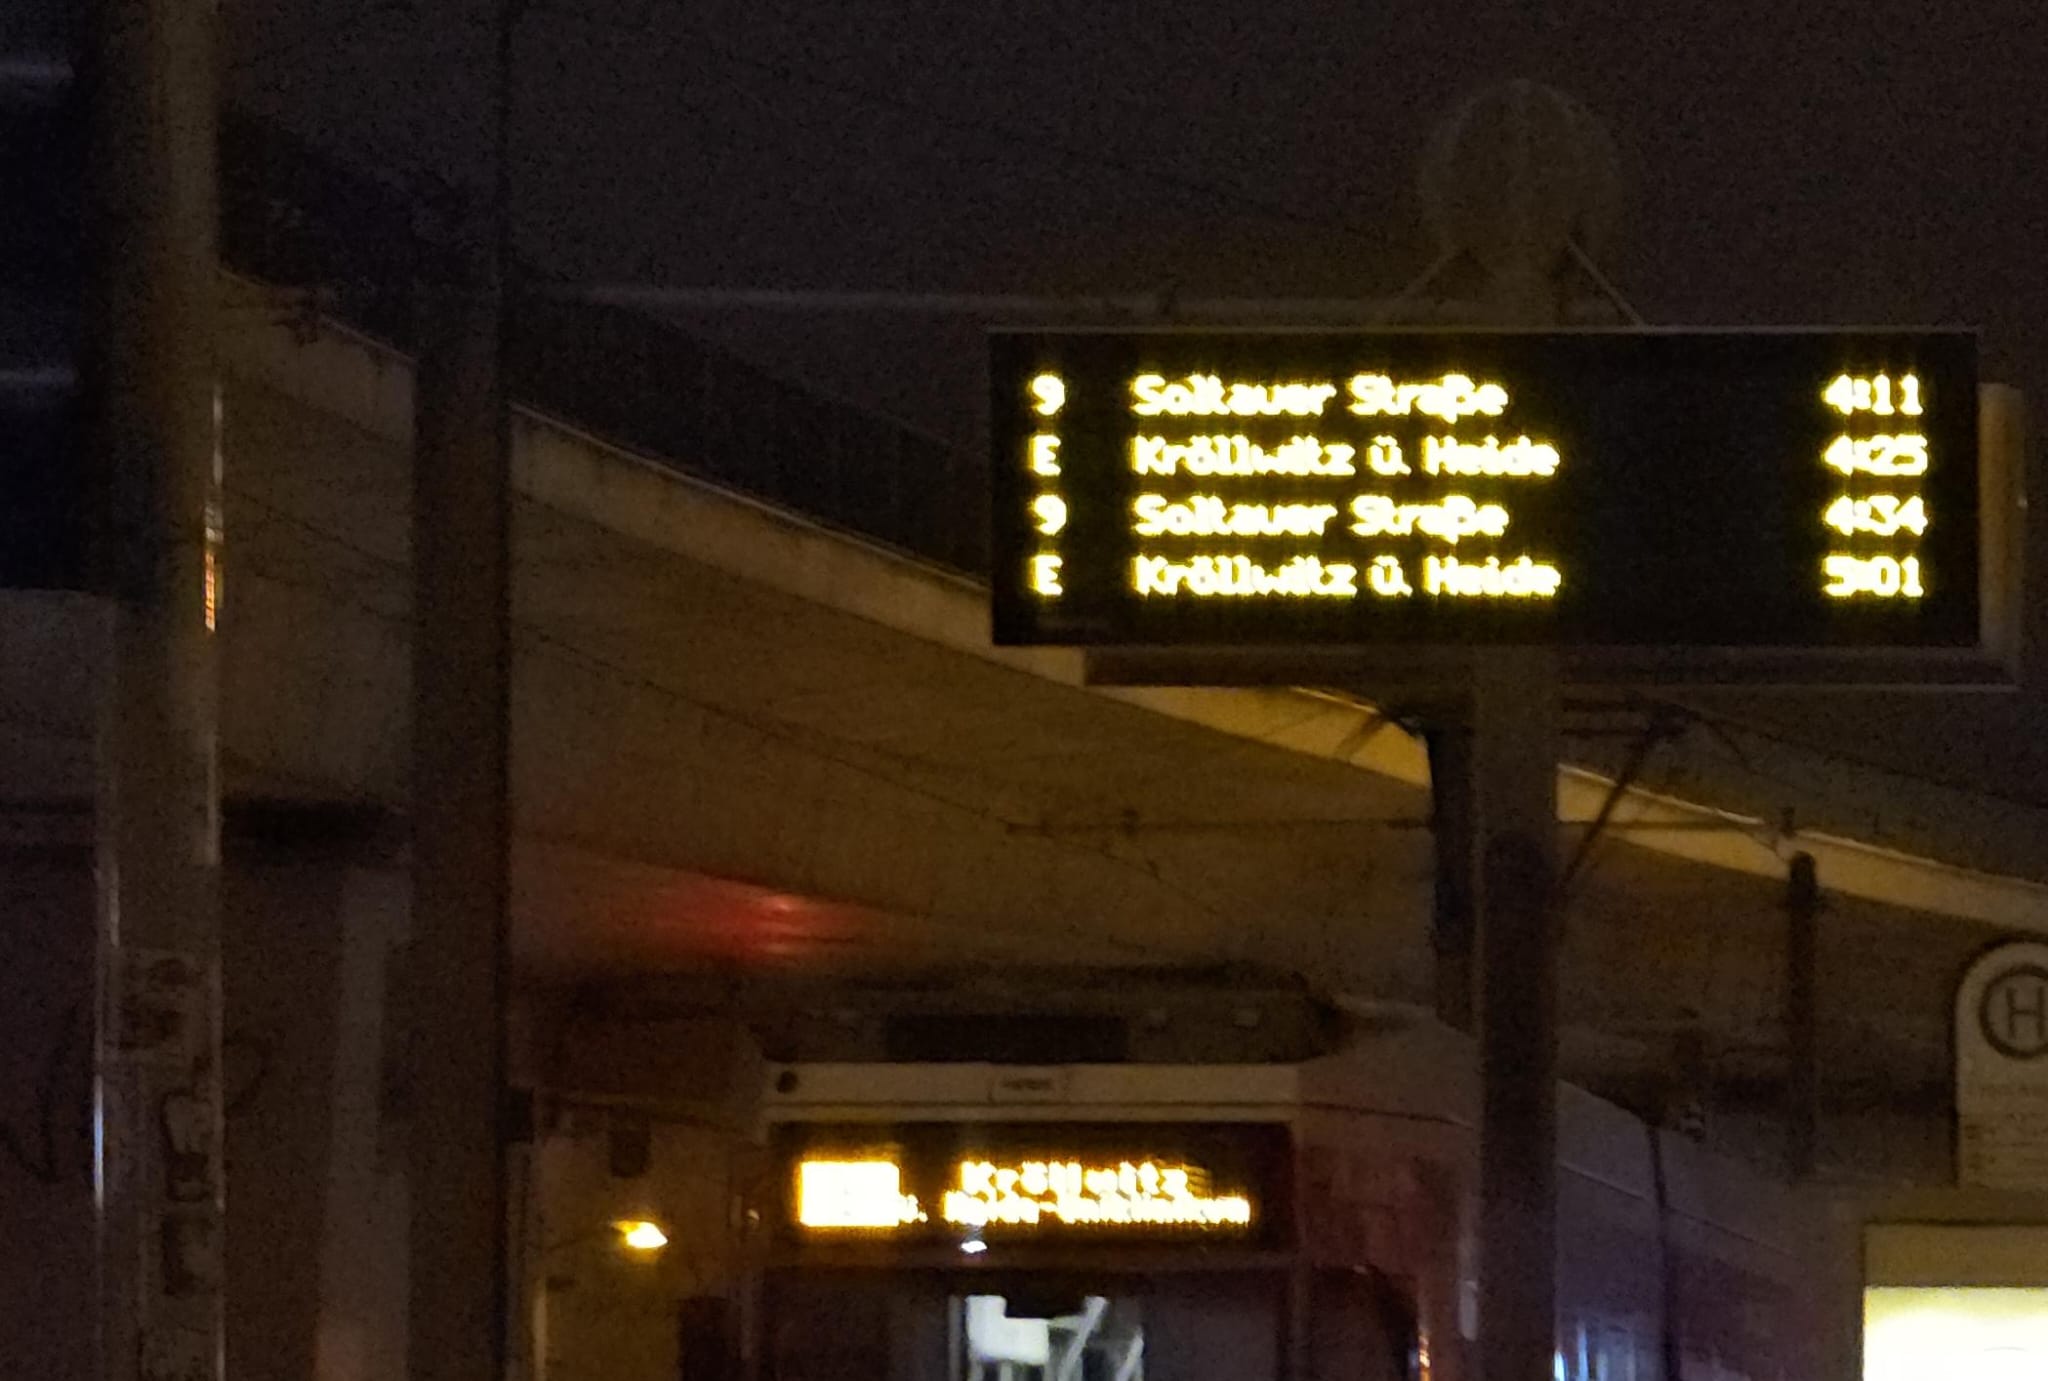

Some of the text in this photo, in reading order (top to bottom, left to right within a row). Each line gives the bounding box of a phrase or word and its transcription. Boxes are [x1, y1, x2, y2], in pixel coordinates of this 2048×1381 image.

[1032, 374, 1923, 424] 9 Soltauer Straße 4:11
[1032, 434, 1060, 475] E
[1131, 434, 1355, 475] Kröllwitz
[1422, 434, 1560, 475] Heide
[1824, 434, 1928, 475] 4:25
[1034, 494, 1928, 544] 9 Soltauer Straße 4:34
[1032, 555, 1062, 596] E
[1134, 555, 1358, 596] Kröllwitz
[1423, 555, 1561, 597] Heide
[1824, 555, 1924, 597] 5:01
